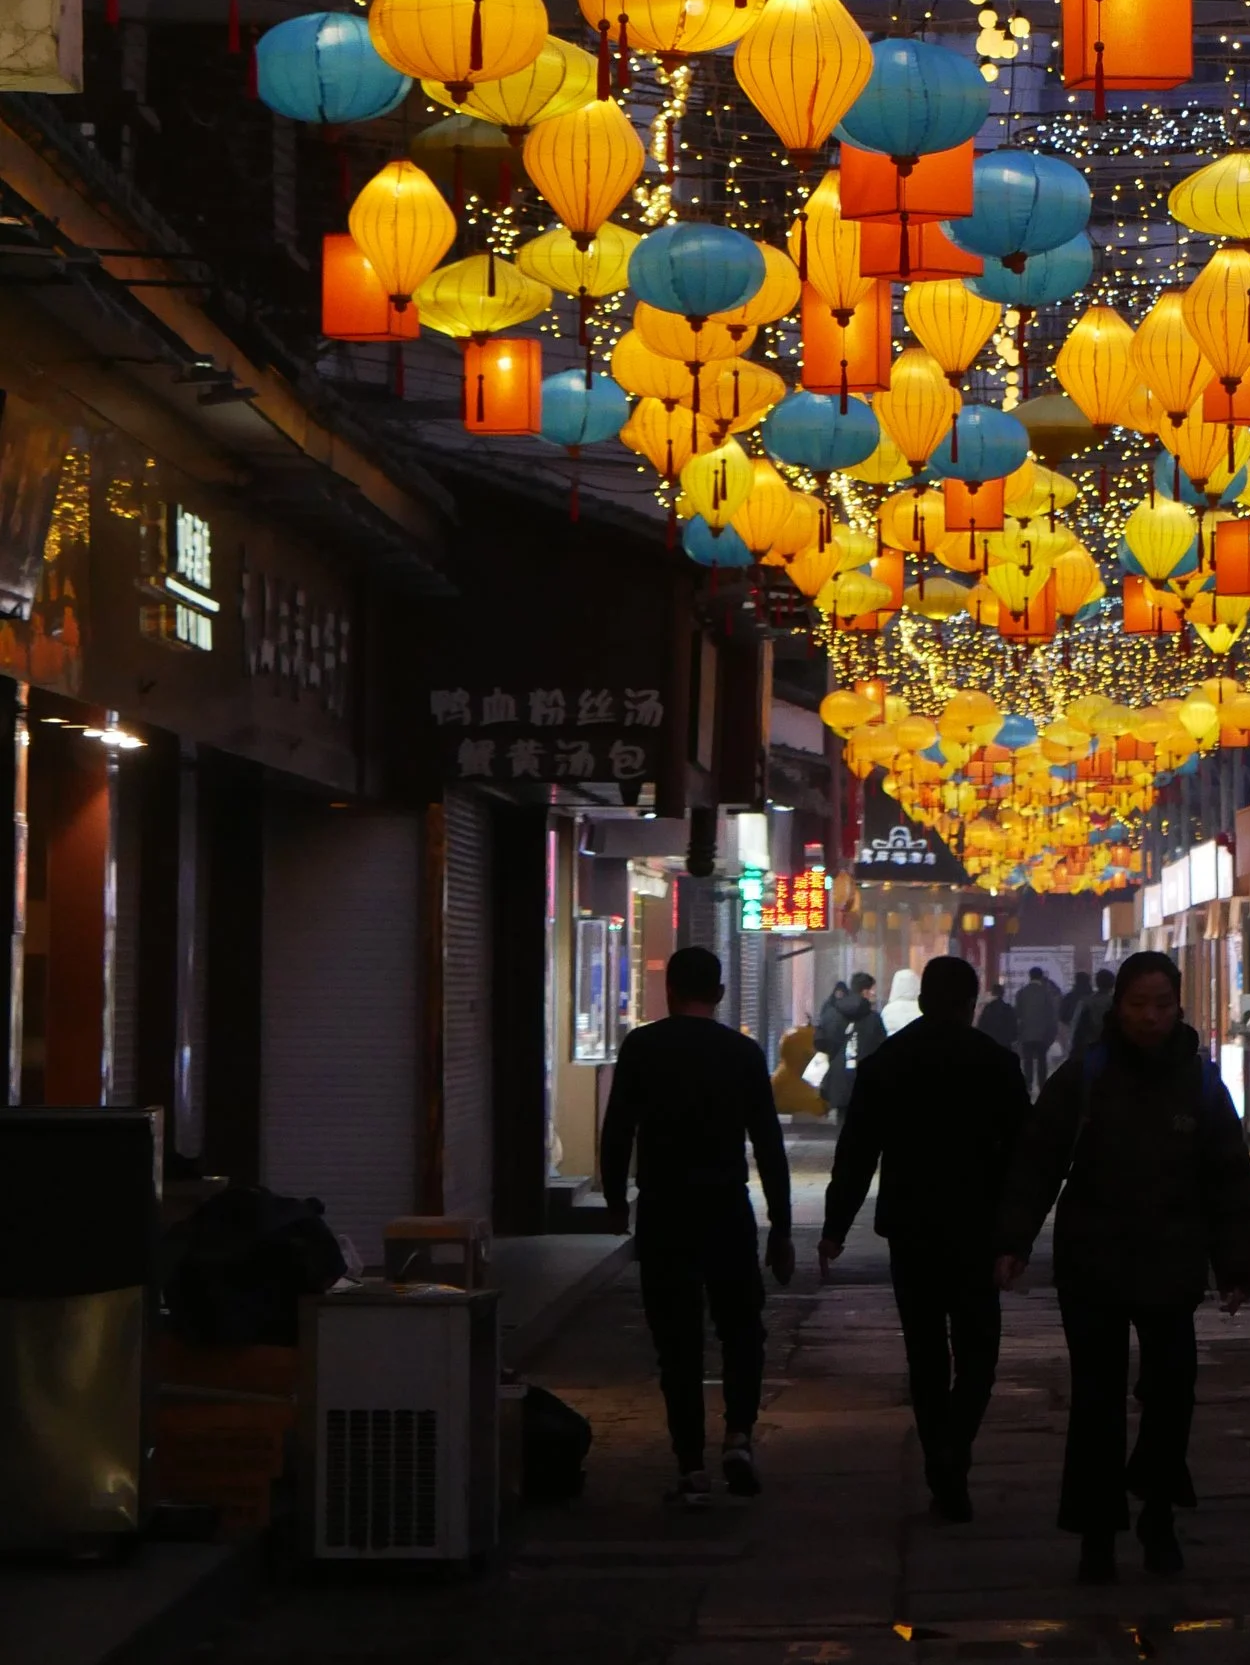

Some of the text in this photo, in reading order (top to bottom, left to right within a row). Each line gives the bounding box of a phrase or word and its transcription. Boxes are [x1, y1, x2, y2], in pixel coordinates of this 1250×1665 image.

[430, 687, 664, 727] 鸭血粉丝汤
[457, 738, 647, 779] 蟹黄汤包
